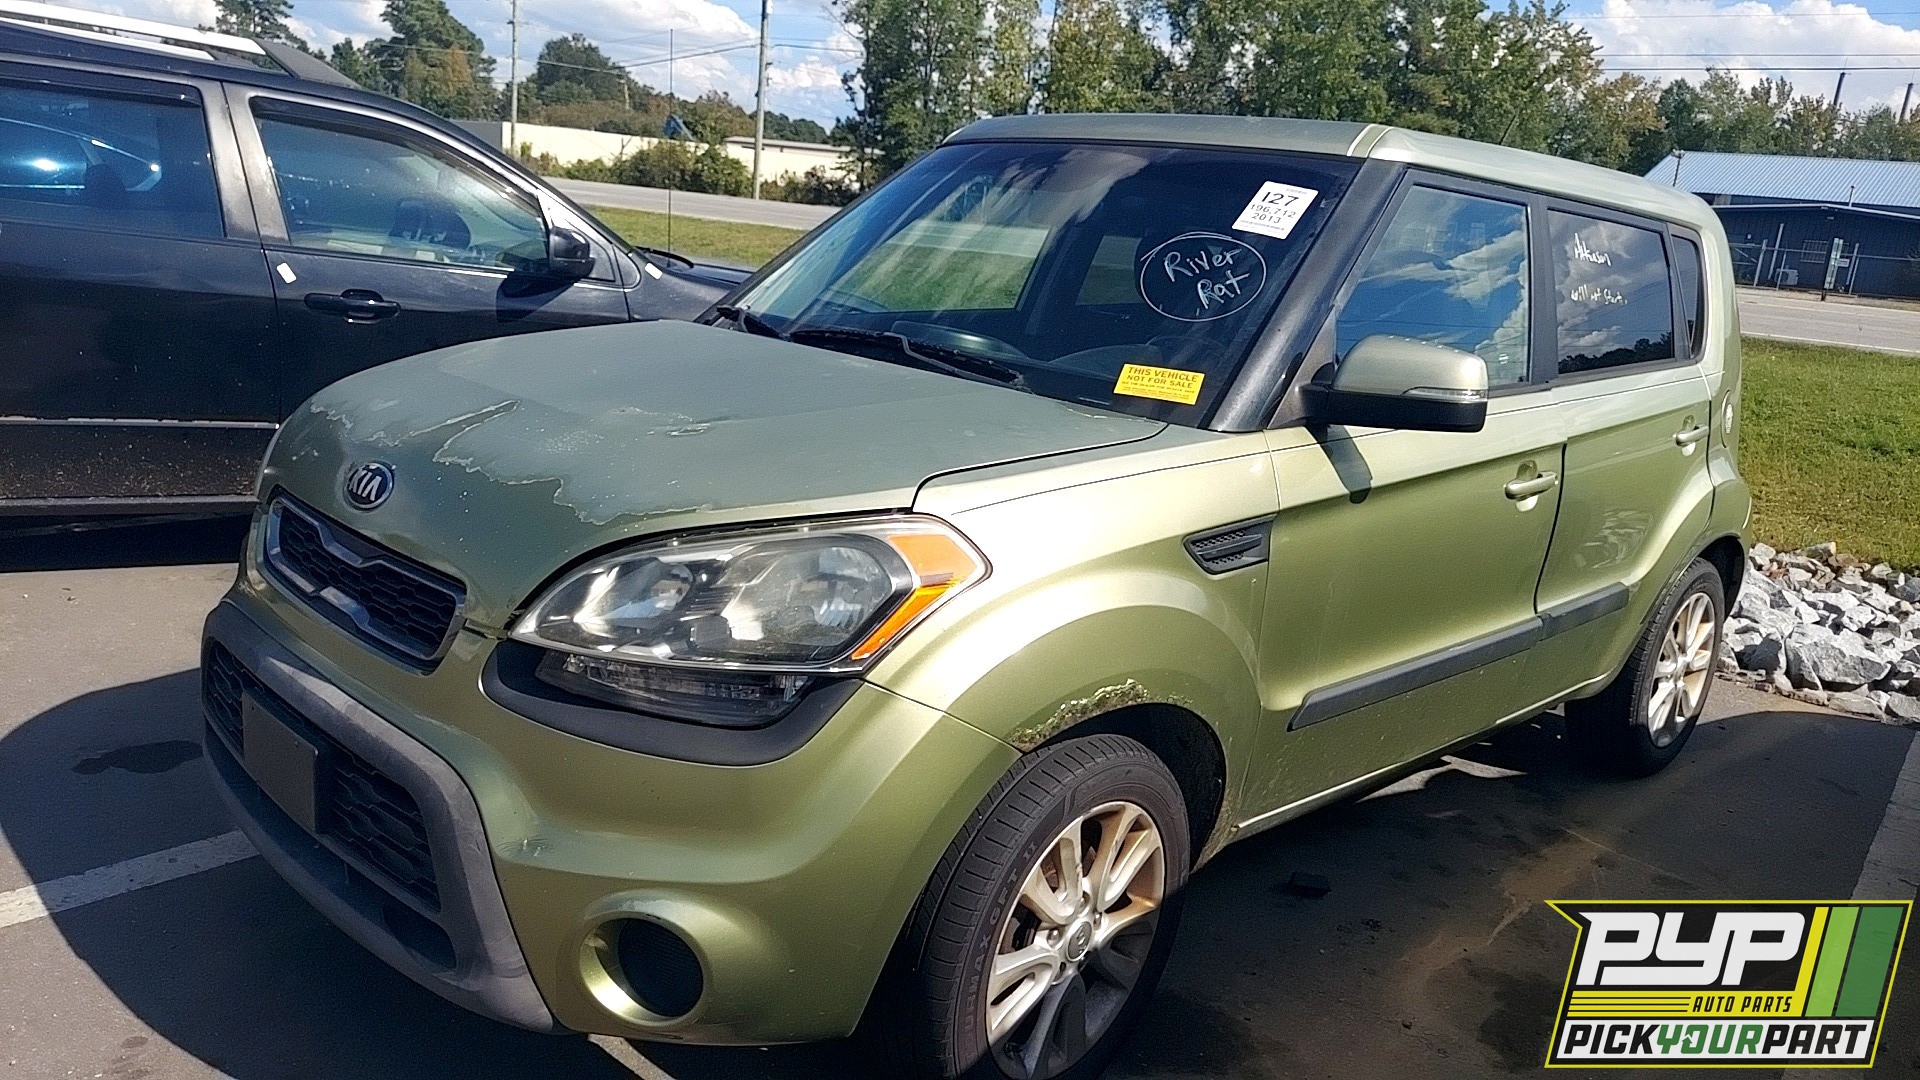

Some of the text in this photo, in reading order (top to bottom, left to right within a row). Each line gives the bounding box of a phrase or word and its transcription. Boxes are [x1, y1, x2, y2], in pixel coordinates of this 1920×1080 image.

[1261, 191, 1299, 207] 127
[1251, 204, 1296, 219] 196,712
[1251, 212, 1282, 224] 2013
[1163, 248, 1242, 282] River
[1197, 269, 1251, 310] Rat
[1128, 366, 1199, 383] THIS VEHICLE
[1147, 377, 1167, 385] FOR
[1170, 380, 1194, 389] SALE
